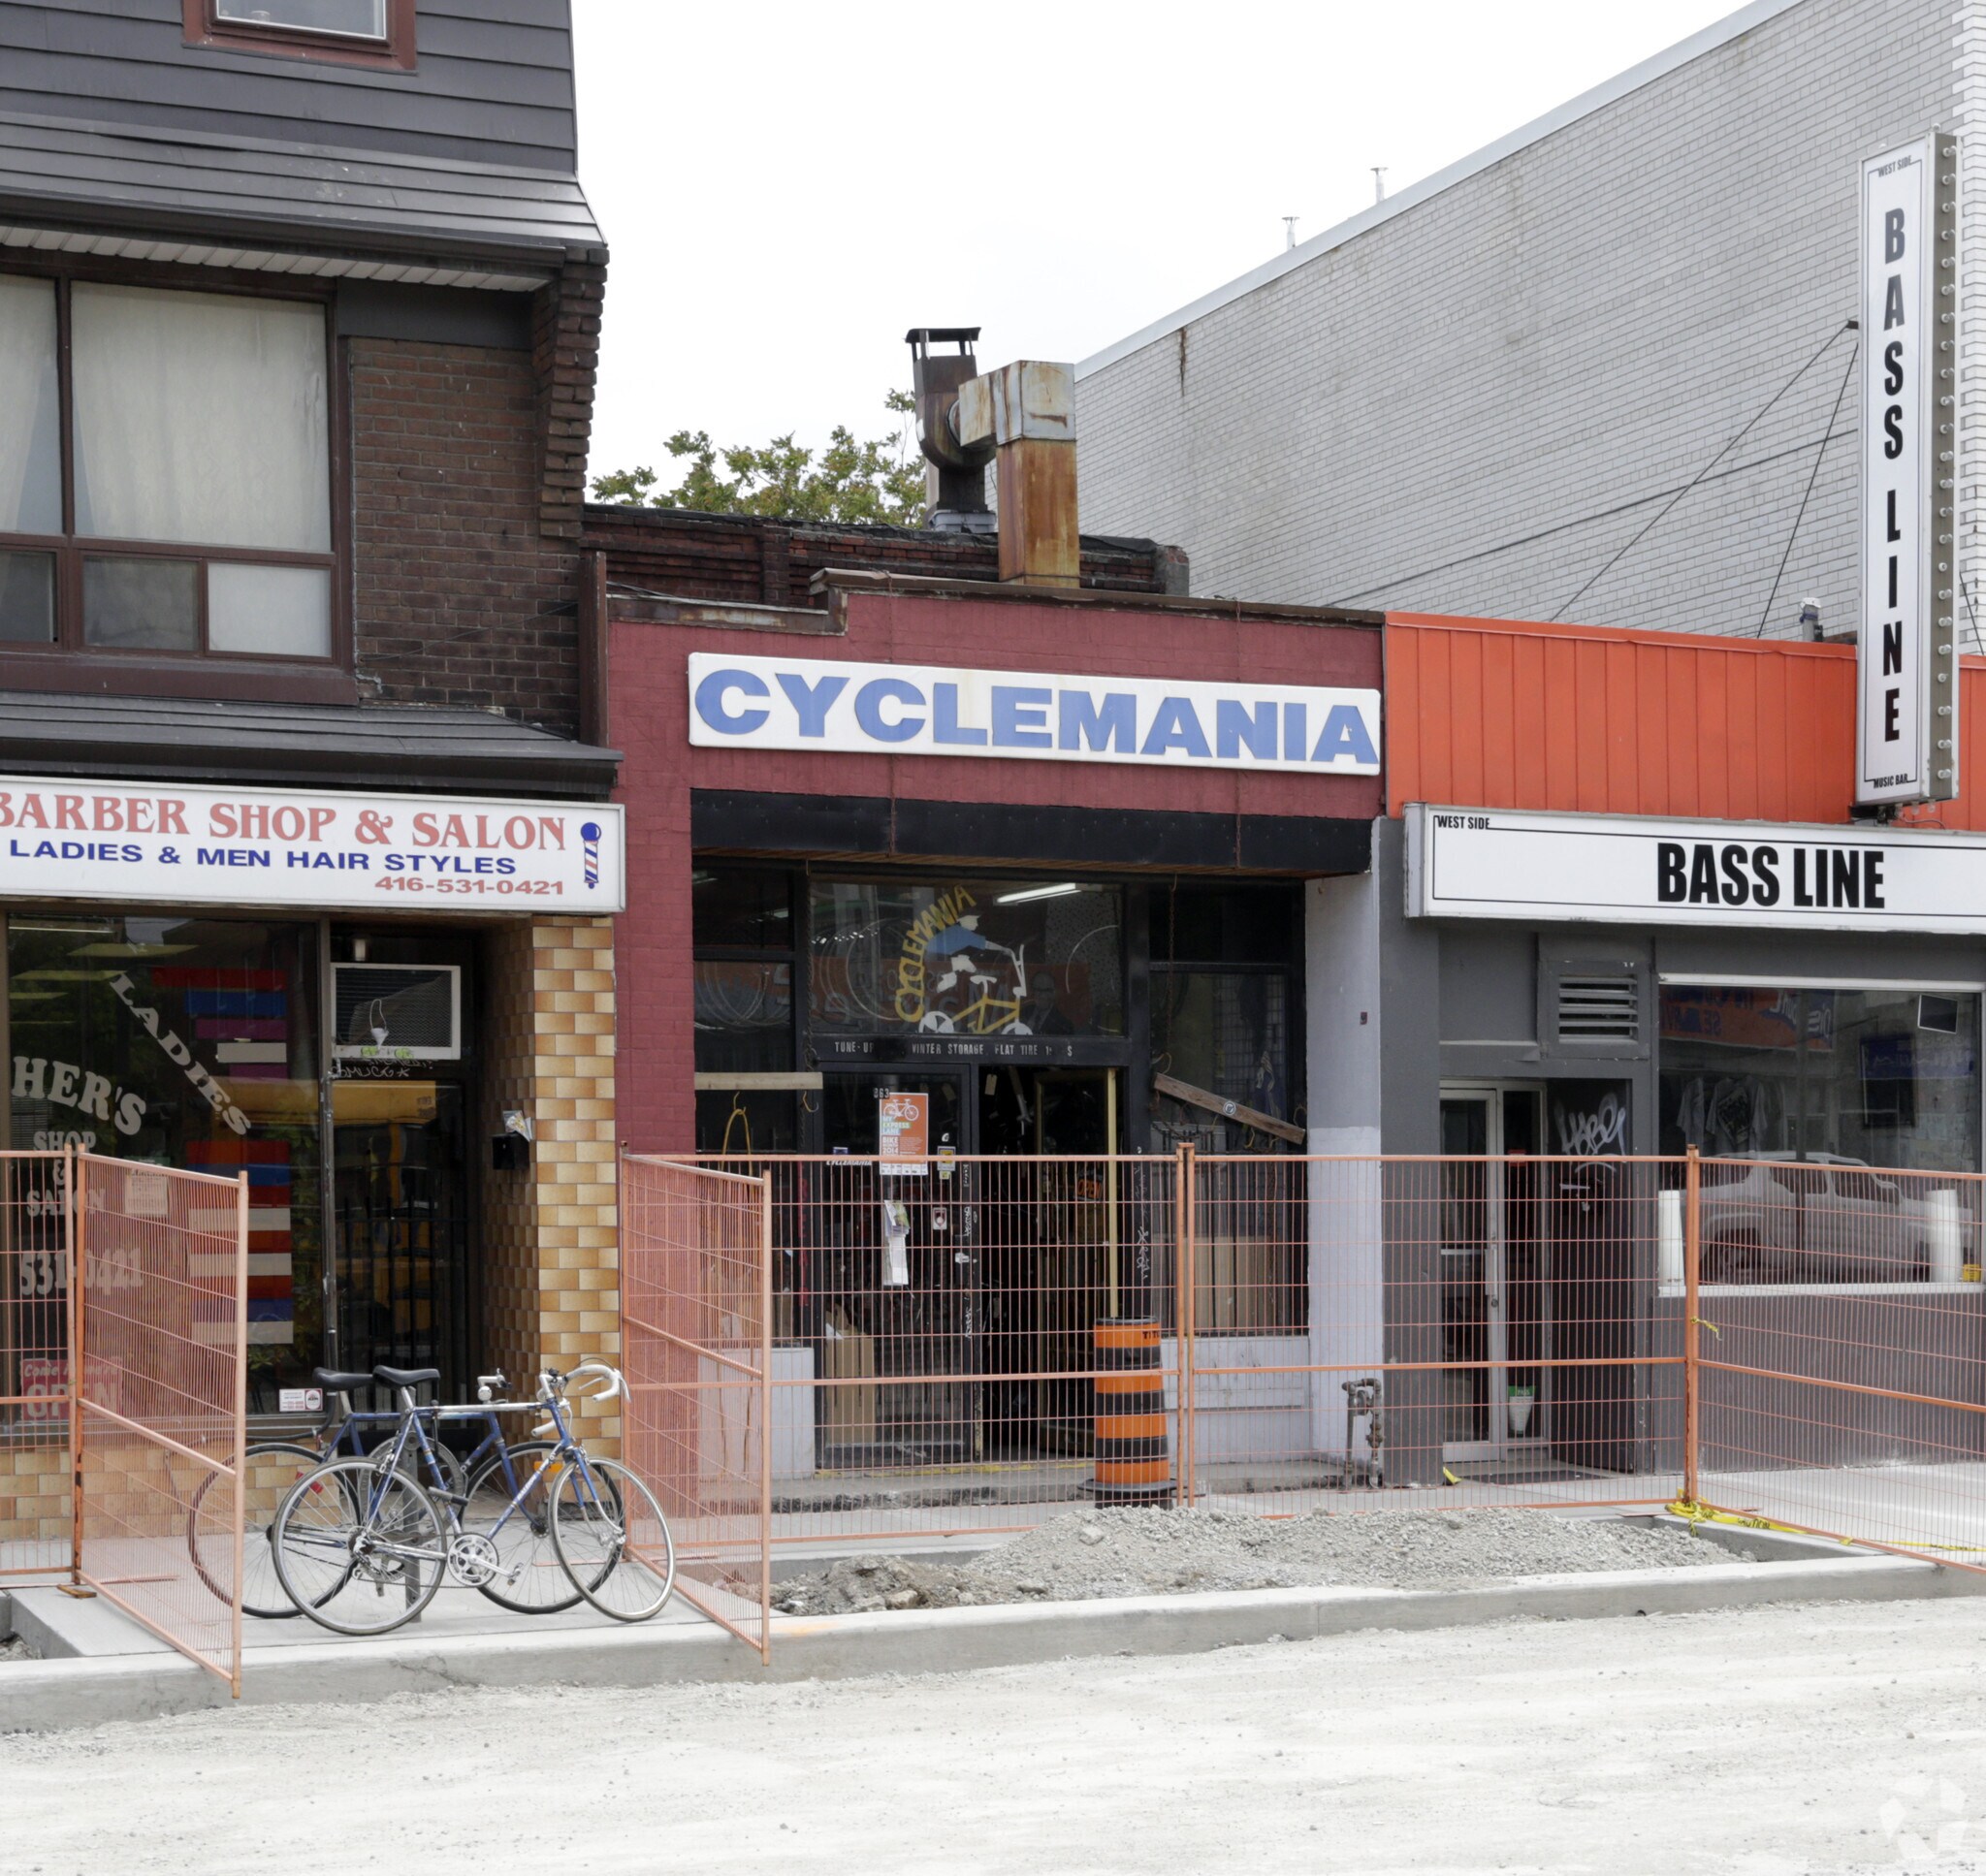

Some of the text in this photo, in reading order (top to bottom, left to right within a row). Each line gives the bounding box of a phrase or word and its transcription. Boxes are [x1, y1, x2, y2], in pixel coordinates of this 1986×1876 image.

[1877, 155, 1912, 177] WEST SIDE
[1882, 207, 1905, 743] BASS LINE
[694, 669, 1379, 765] CYCLEMANIA
[1874, 773, 1908, 788] MUSIC BAR
[208, 803, 336, 843] SHOP
[354, 811, 394, 845] &
[411, 812, 566, 851] SALON
[1437, 814, 1490, 831] WEST SIDE
[10, 839, 517, 874] LADIES & MEN HAIR STYLES
[374, 875, 564, 895] 416-531-0421
[1657, 843, 1885, 909] BASS LINE
[895, 883, 977, 1023] CYCLEMANIA
[109, 973, 251, 1135] LADIES
[912, 1043, 942, 1055] WINTER
[947, 1044, 984, 1056] STORAGE
[994, 1045, 1014, 1056] FLAT
[1020, 1045, 1039, 1056] TIRE
[12, 1056, 146, 1135] HER'S
[33, 1130, 97, 1157] SHOP
[1077, 1179, 1101, 1198] OPEN
[27, 1383, 117, 1418] OPN
